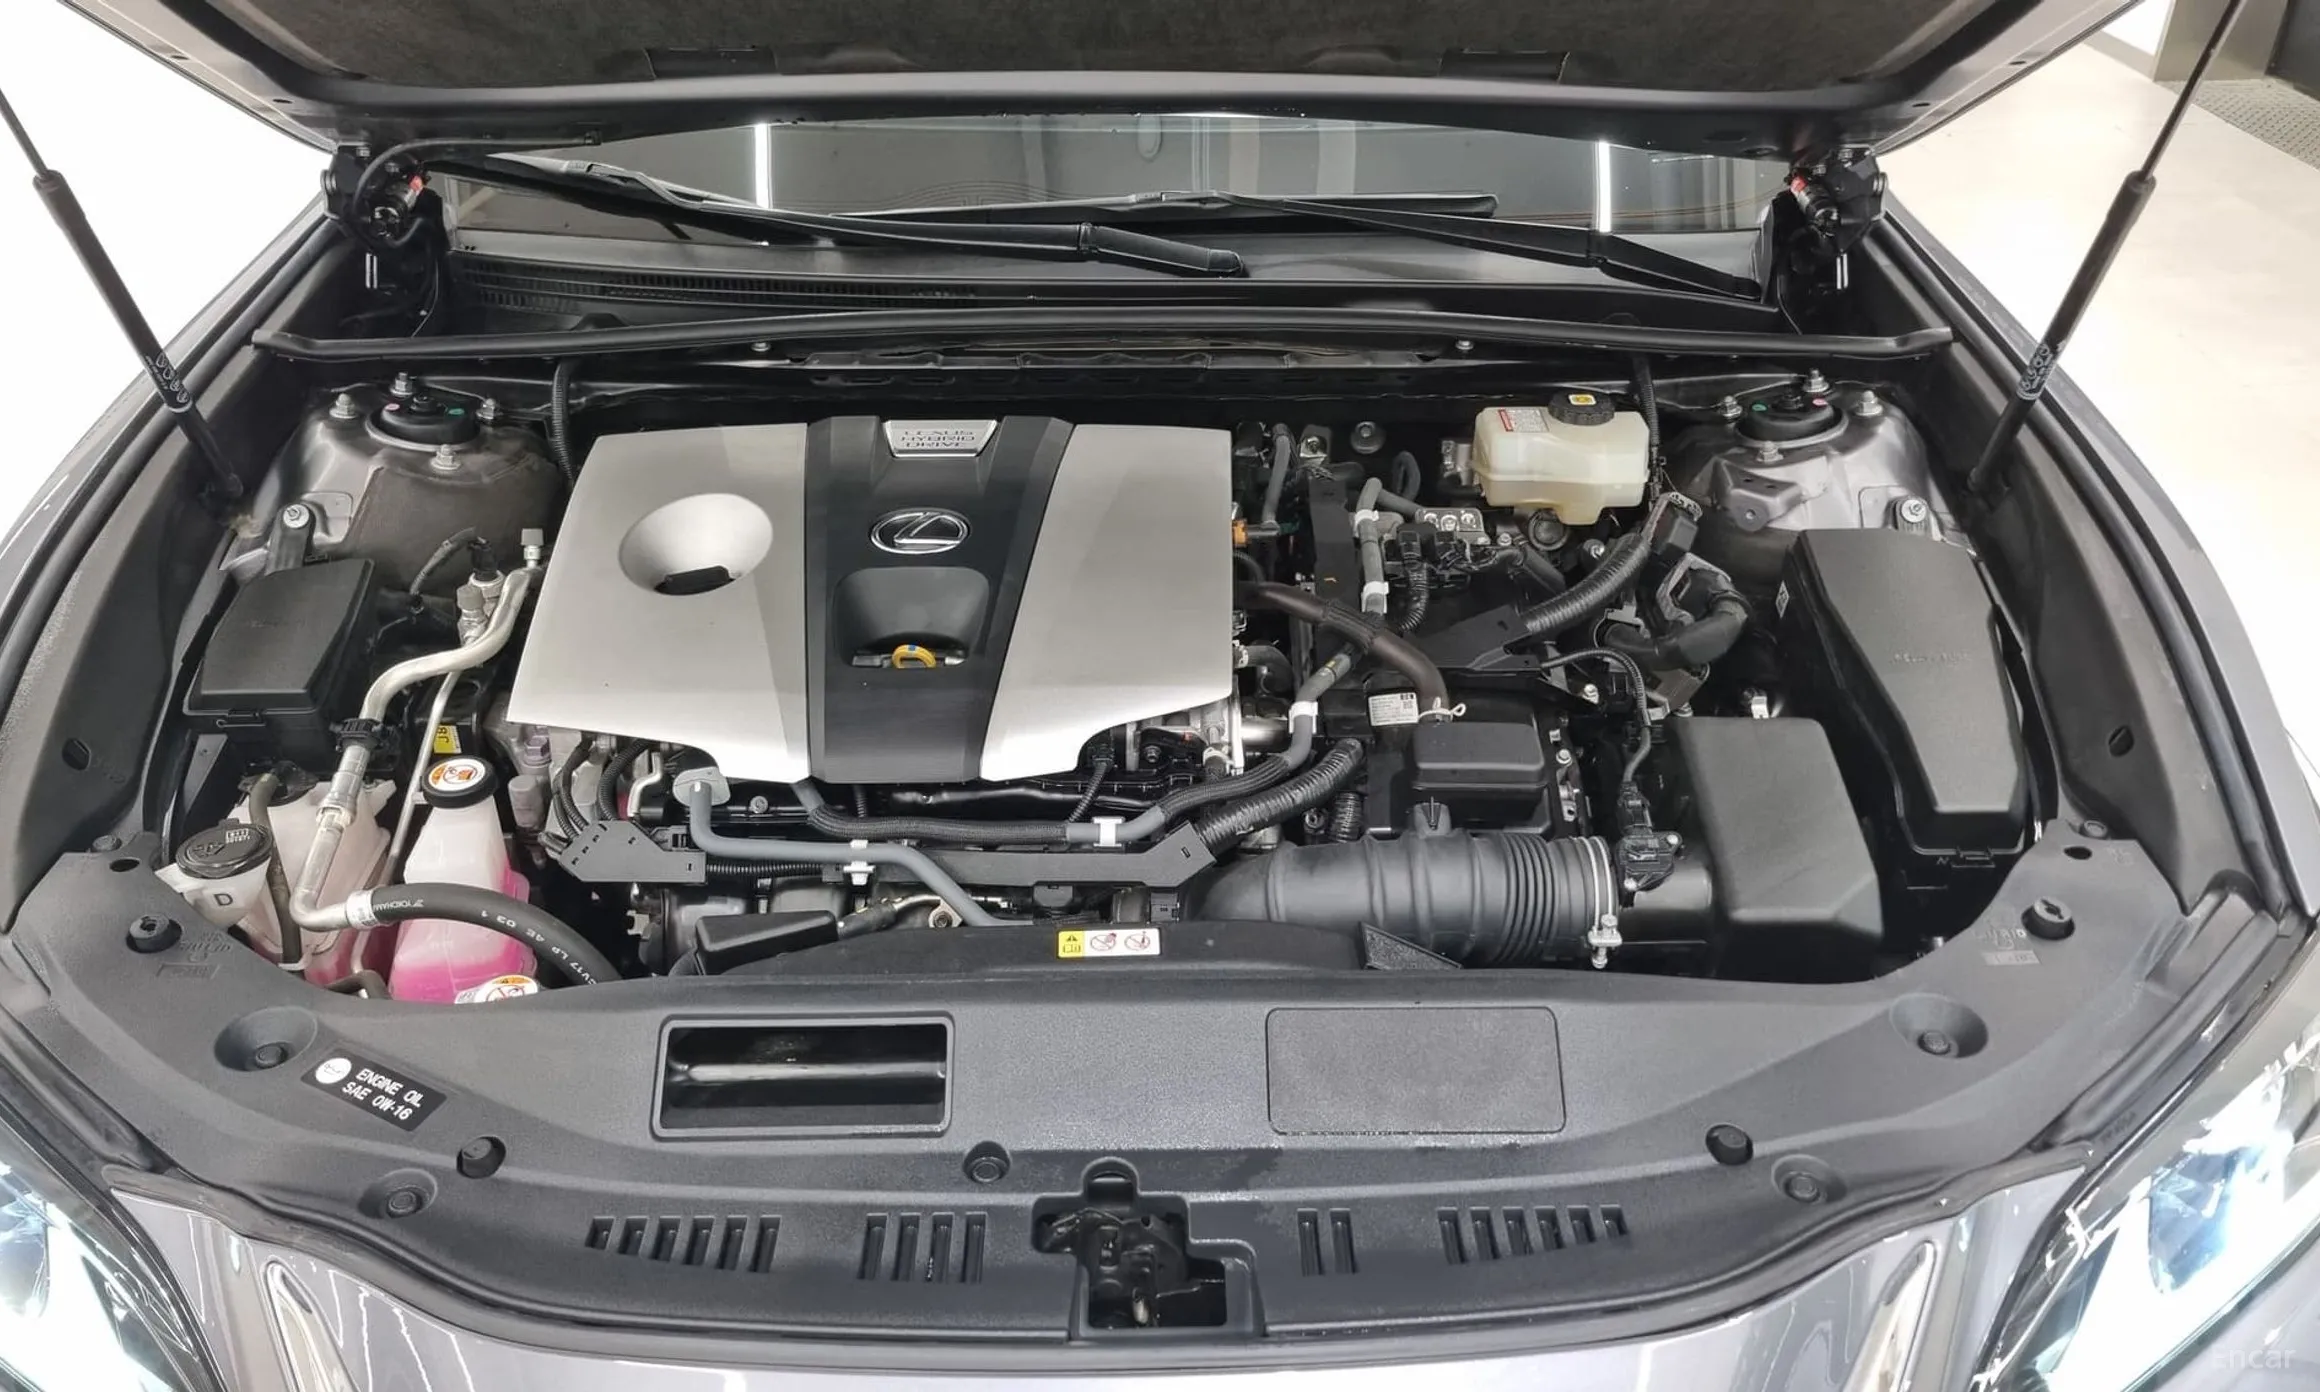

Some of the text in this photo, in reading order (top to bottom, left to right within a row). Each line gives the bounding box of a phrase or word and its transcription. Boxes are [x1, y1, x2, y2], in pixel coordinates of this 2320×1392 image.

[341, 1081, 373, 1101] SAE
[355, 1068, 424, 1108] ENGINE OIL
